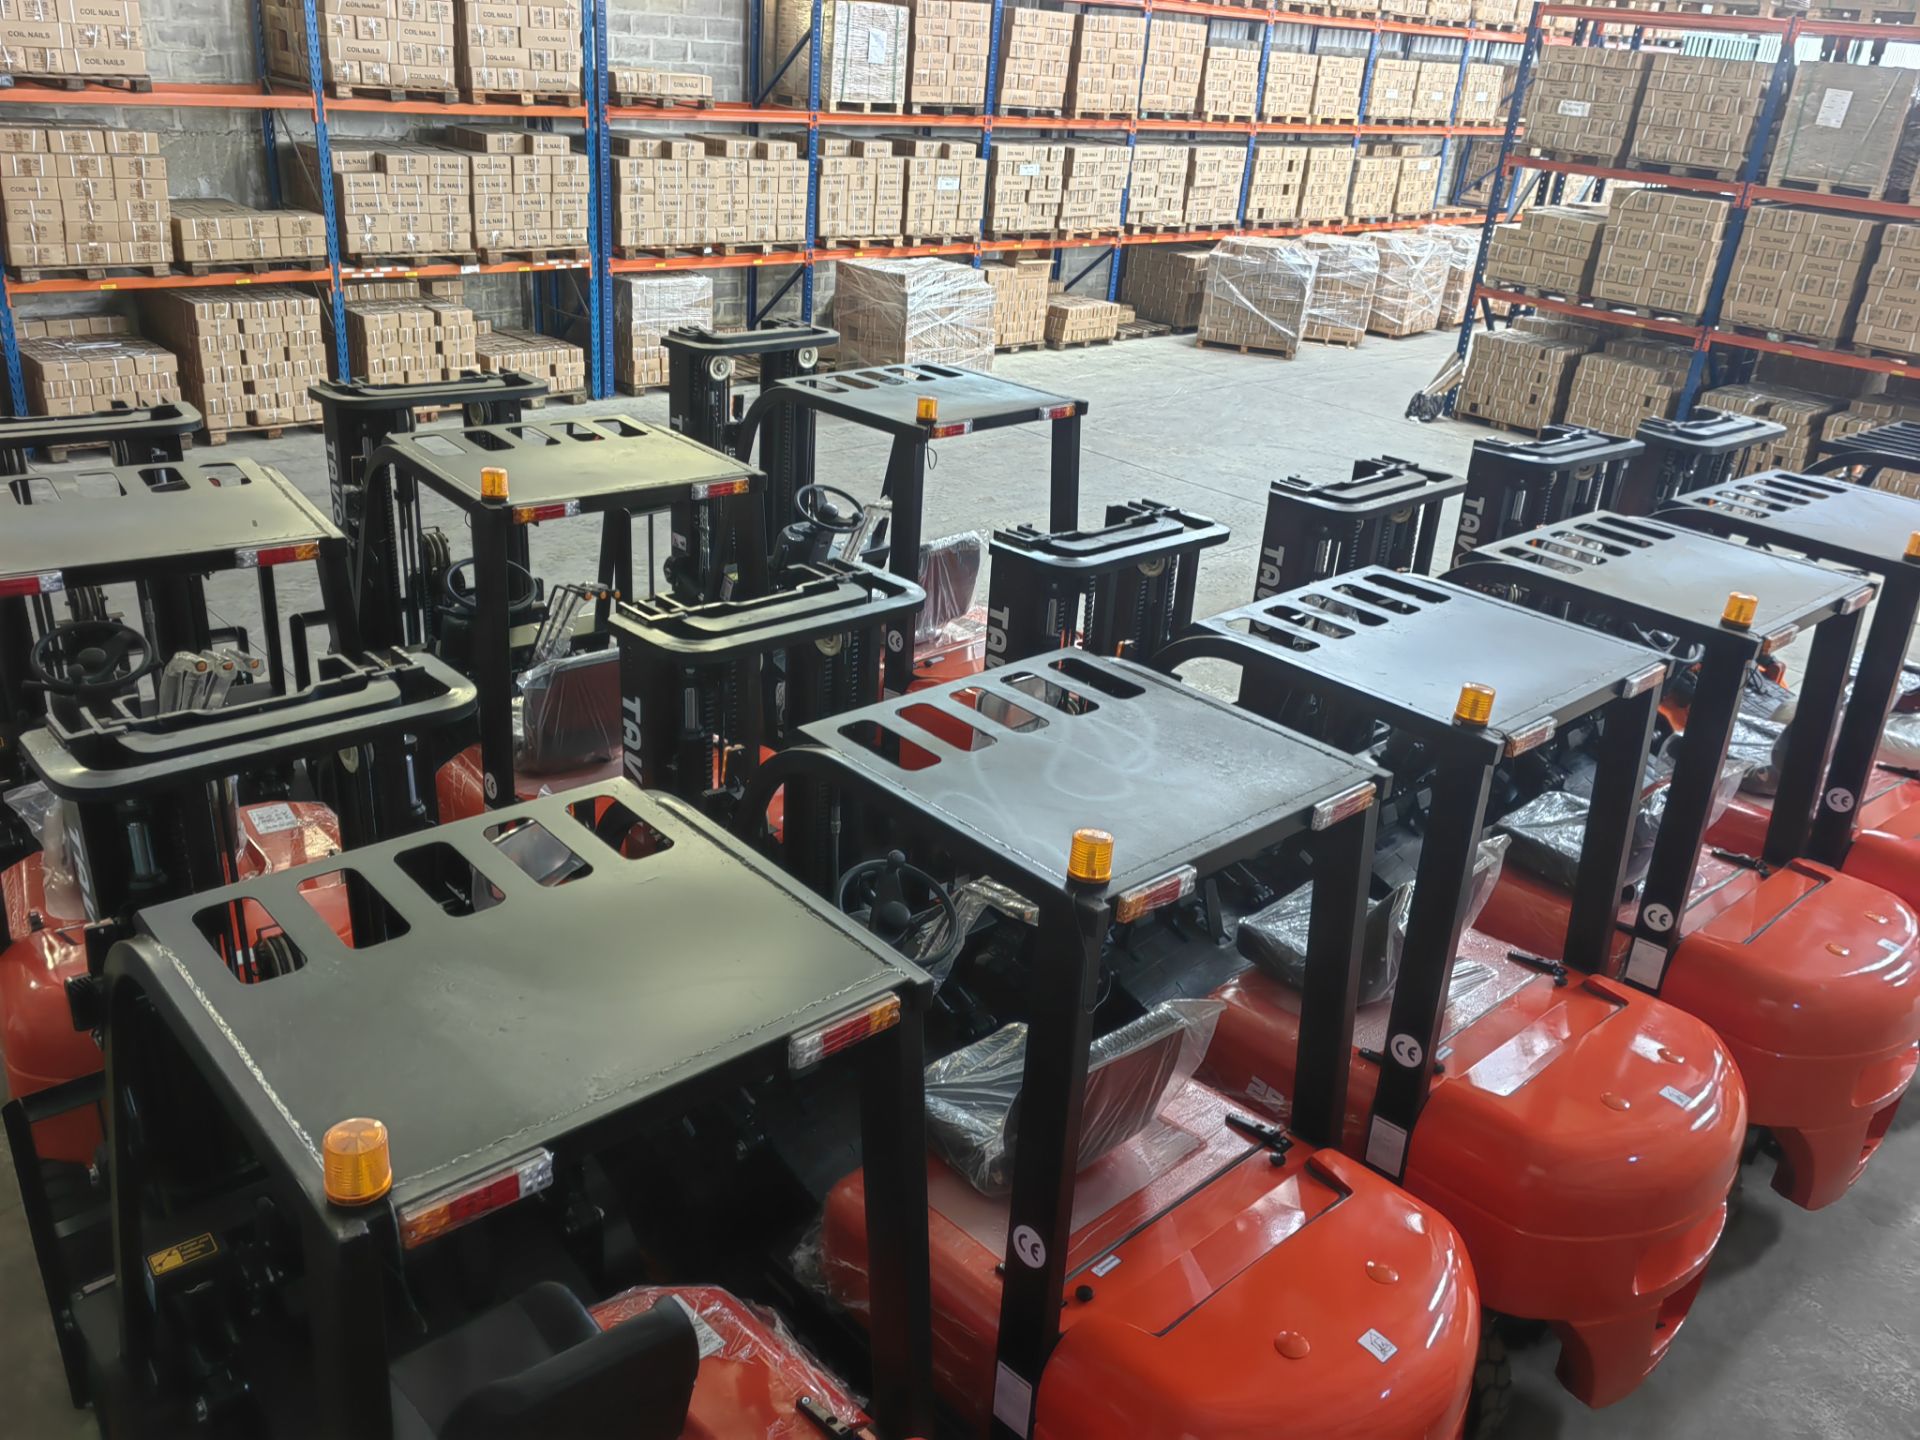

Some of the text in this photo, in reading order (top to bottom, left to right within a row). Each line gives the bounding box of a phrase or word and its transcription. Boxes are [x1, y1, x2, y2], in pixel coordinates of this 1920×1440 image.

[1830, 793, 1850, 808] CE
[1648, 910, 1668, 927] CE
[1396, 1041, 1417, 1062] CE
[1018, 1233, 1040, 1262] CE
